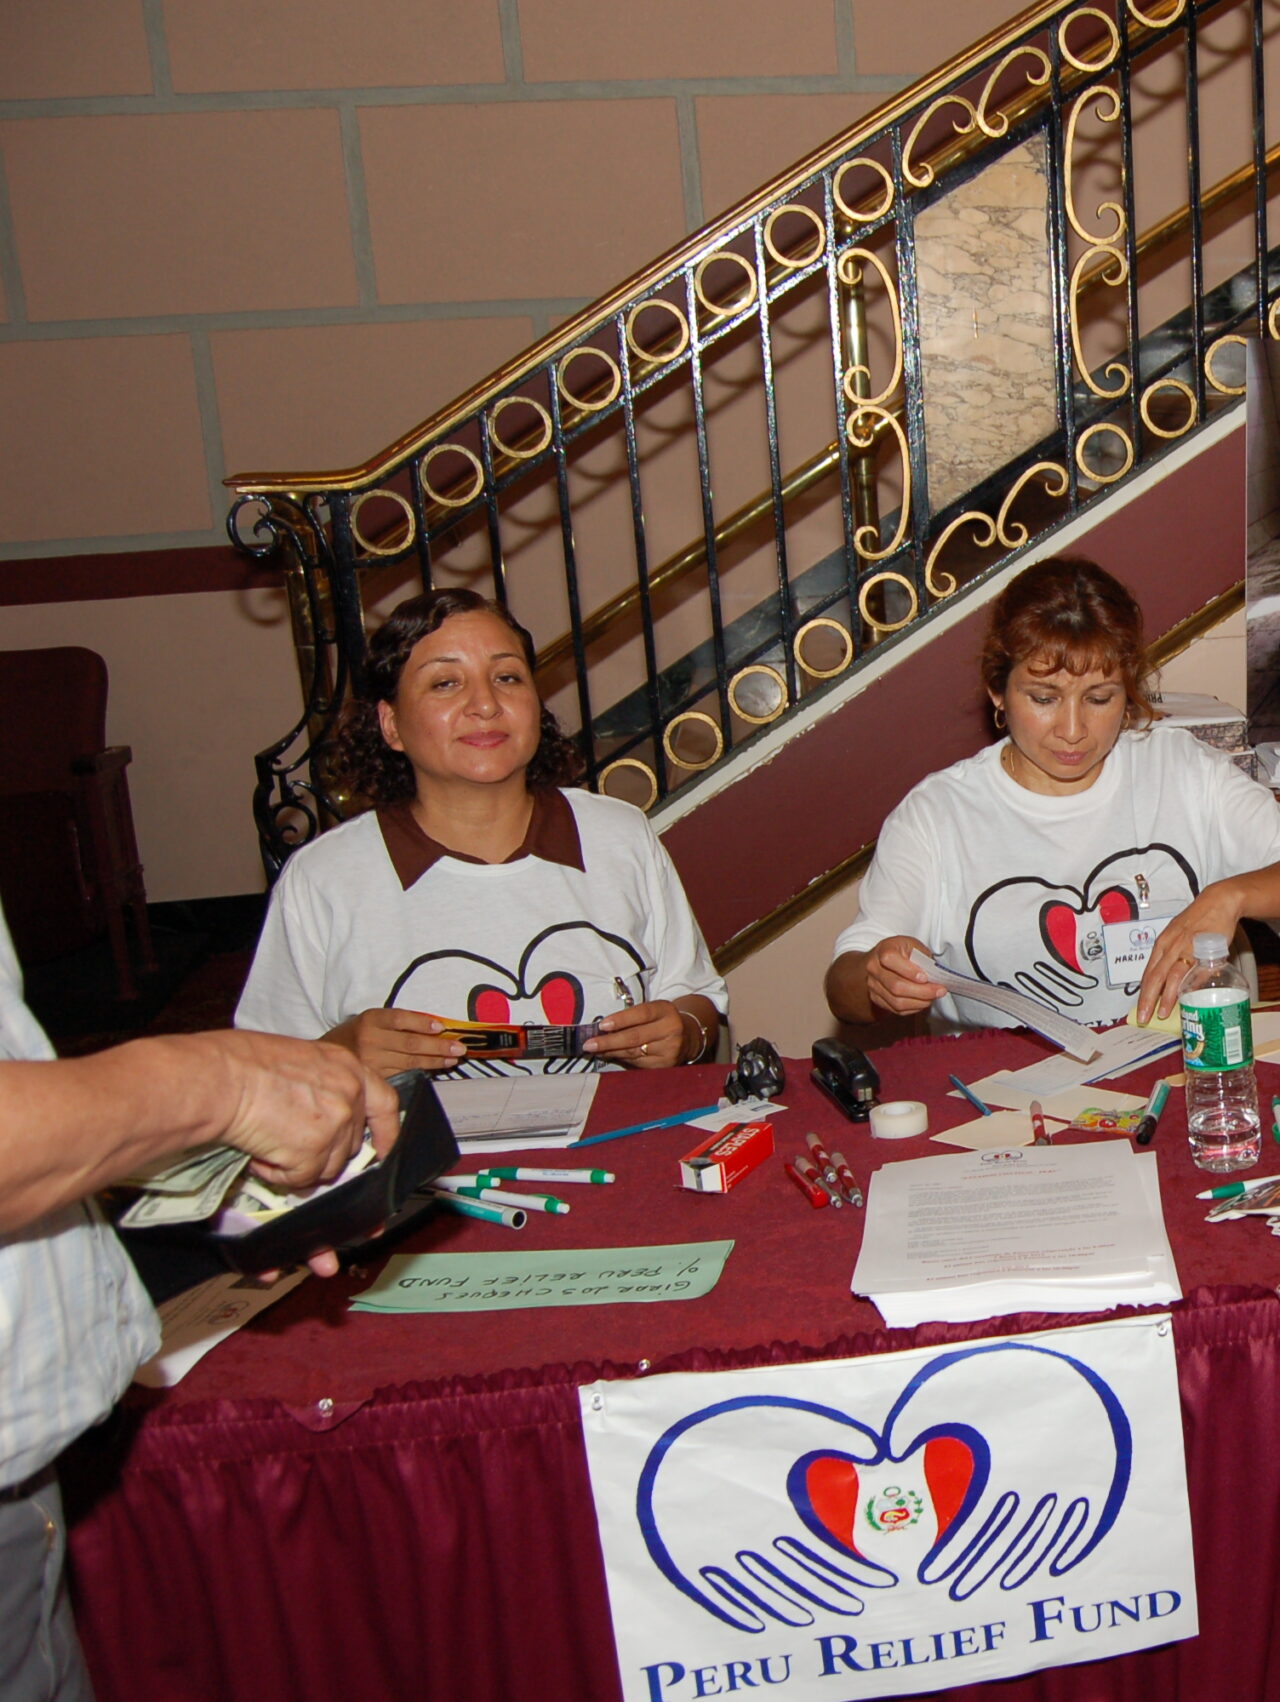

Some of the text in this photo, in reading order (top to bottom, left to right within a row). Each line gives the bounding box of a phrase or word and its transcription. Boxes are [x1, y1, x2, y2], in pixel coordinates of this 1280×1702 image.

[1114, 953, 1145, 964] MARIA
[714, 1127, 761, 1157] STAPLES
[483, 1270, 587, 1287] RELIEF
[599, 1265, 663, 1279] PERU
[398, 1276, 471, 1290] FUND
[639, 1589, 1182, 1702] PERU RELIEF FUND
